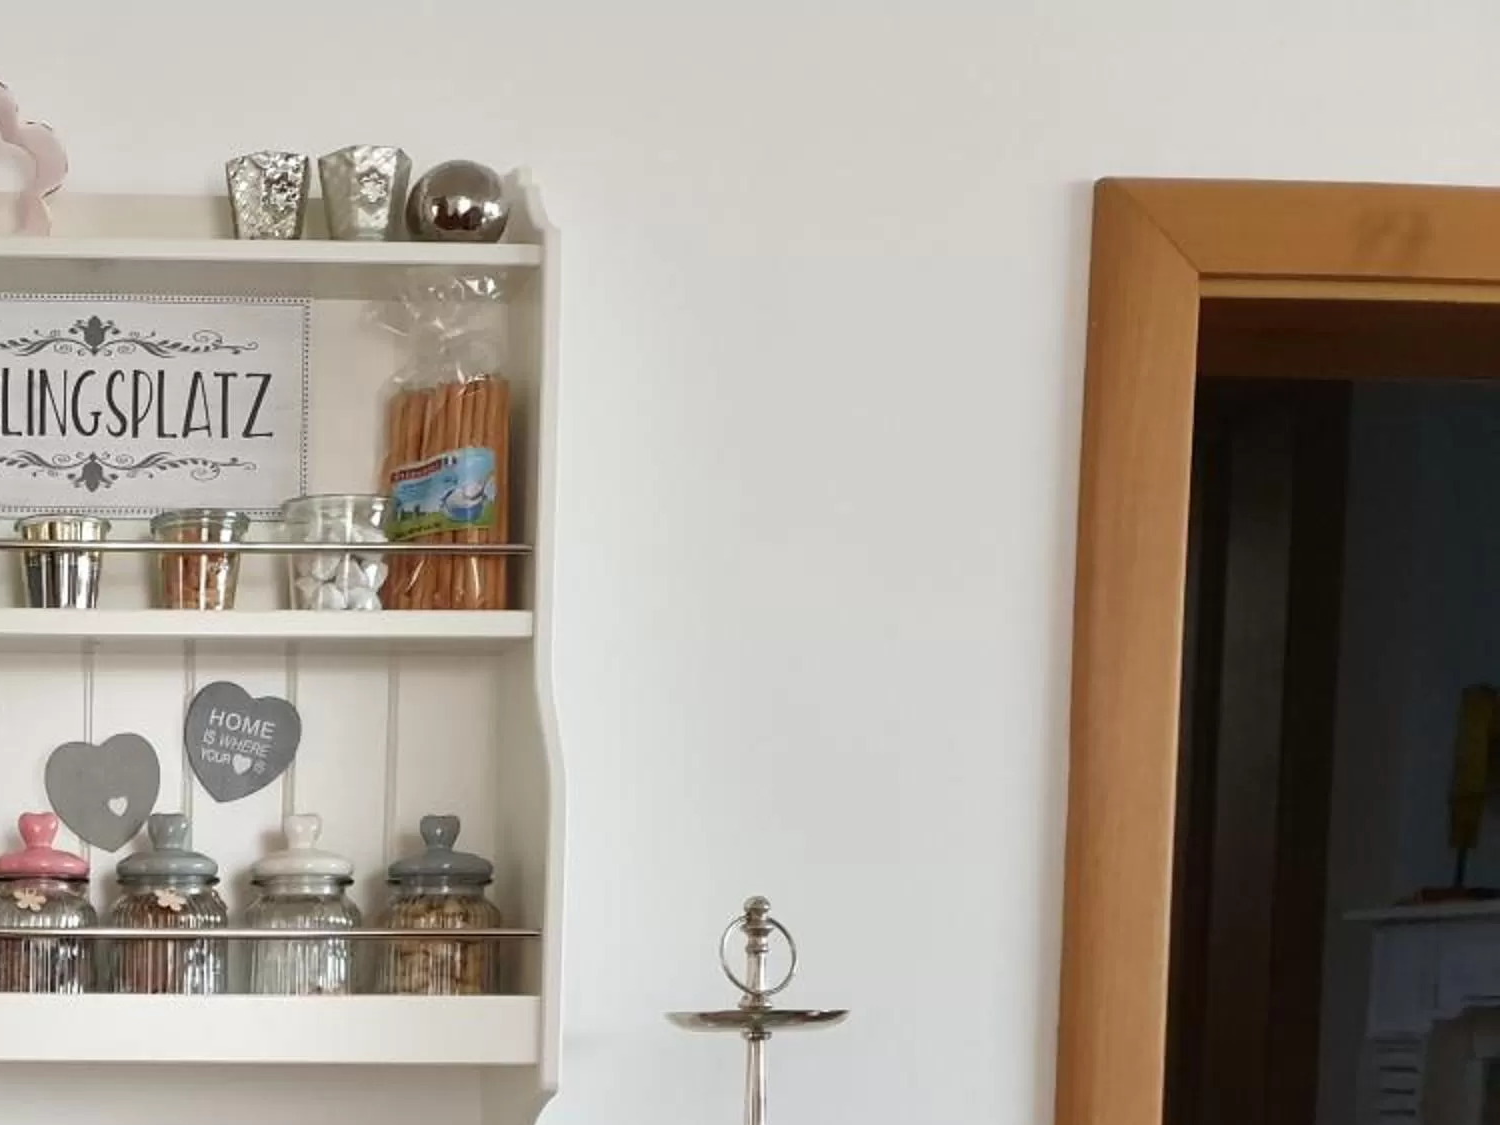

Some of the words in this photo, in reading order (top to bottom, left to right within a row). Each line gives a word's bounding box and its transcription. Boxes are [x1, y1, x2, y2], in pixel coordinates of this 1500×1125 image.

[209, 707, 276, 740] HOME
[201, 747, 231, 765] YOUR
[203, 728, 216, 745] IS
[219, 733, 272, 758] WHERE
